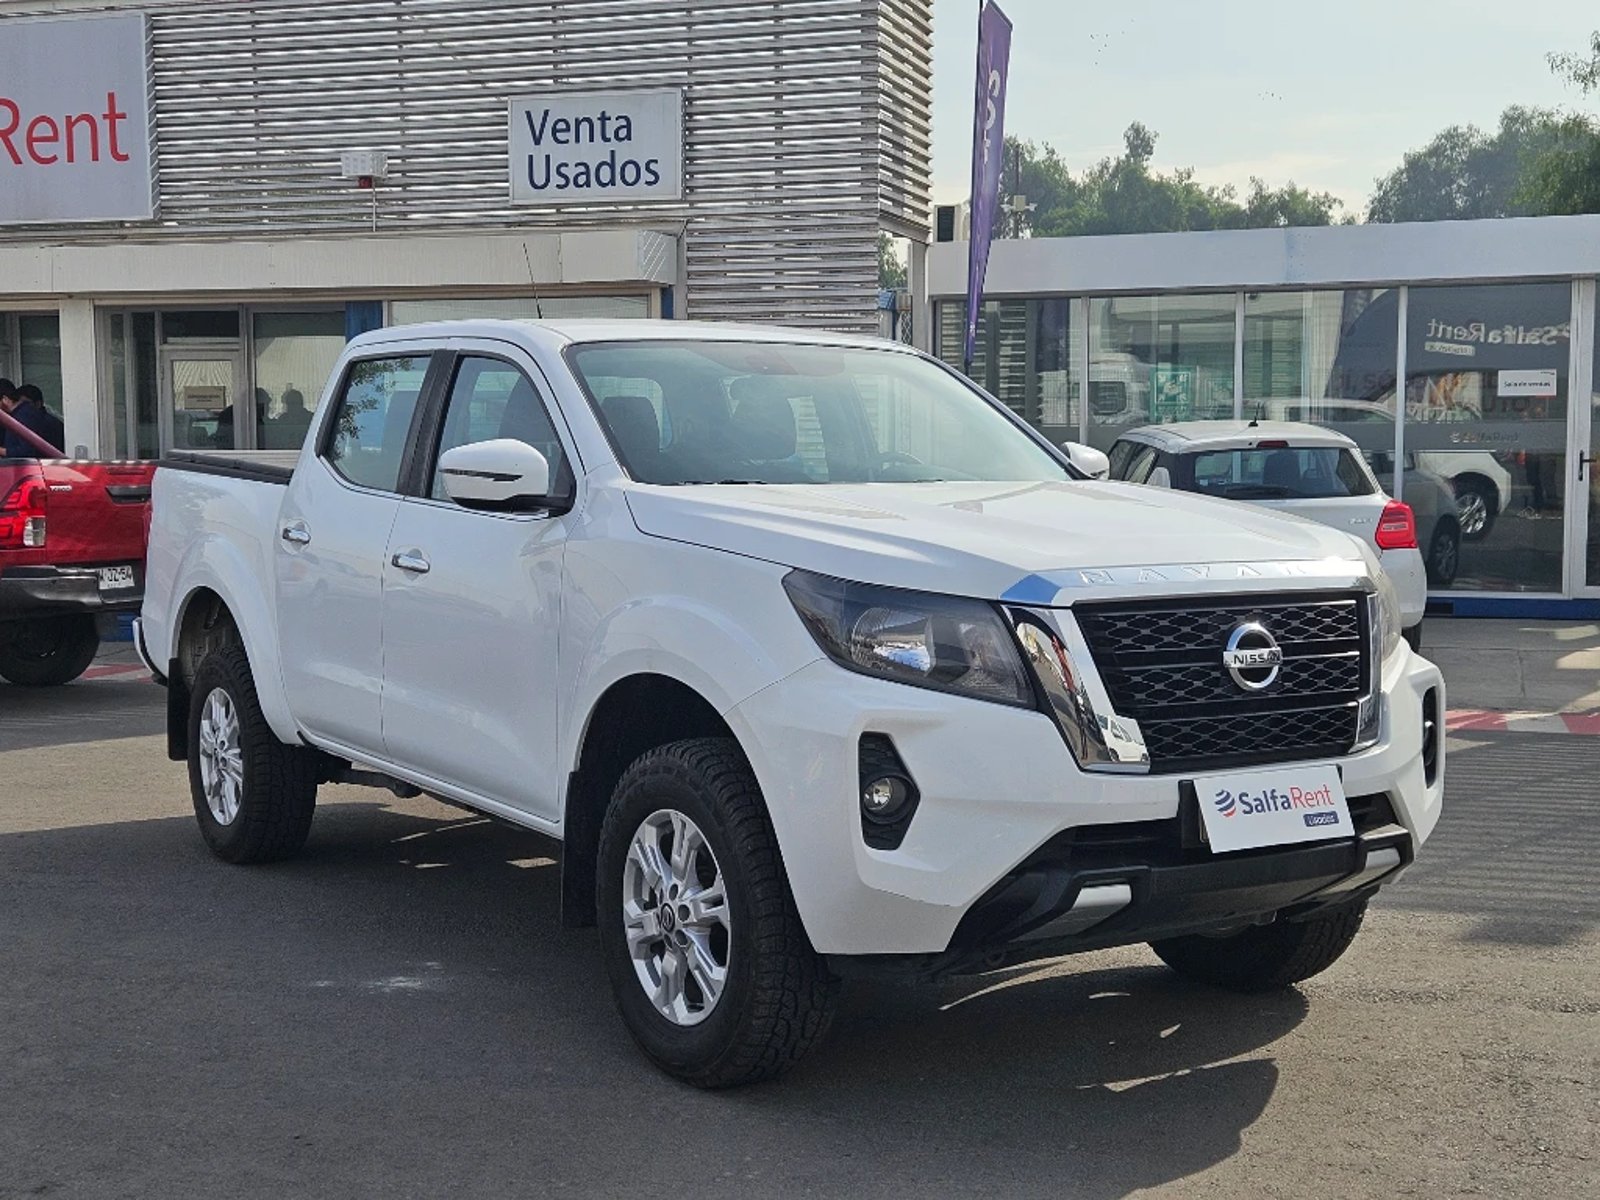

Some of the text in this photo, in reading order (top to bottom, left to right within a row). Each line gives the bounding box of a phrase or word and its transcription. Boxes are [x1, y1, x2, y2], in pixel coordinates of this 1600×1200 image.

[0, 91, 130, 165] Rent
[525, 109, 632, 145] Venta
[528, 150, 660, 189] Usados
[1233, 650, 1280, 665] NISSAN
[1238, 784, 1335, 815] SalfaRent
